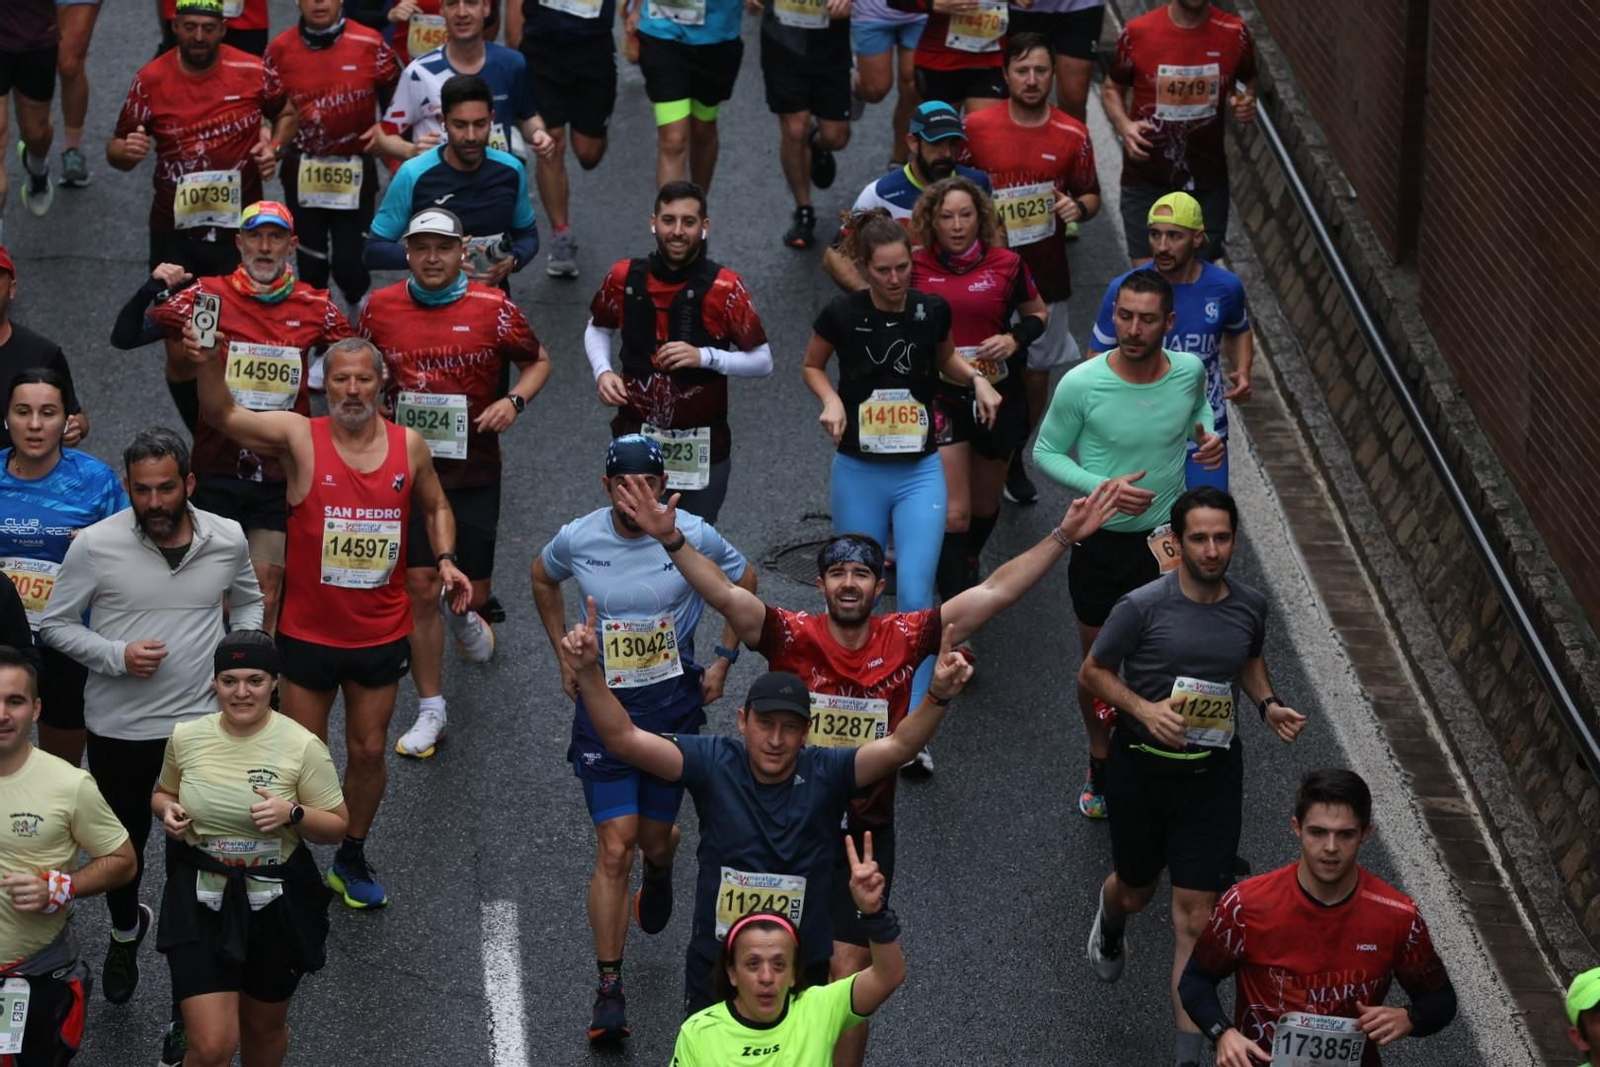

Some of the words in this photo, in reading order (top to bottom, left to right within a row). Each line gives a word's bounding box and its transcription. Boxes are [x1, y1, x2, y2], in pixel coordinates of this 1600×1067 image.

[1166, 80, 1205, 97] 4719
[305, 167, 353, 185] 11659
[180, 186, 230, 206] 10739
[996, 198, 1046, 223] 11623
[233, 358, 290, 383] 14596
[405, 409, 450, 431] 9524
[864, 405, 919, 425] 14165
[3, 517, 39, 527] CLUB
[324, 506, 353, 518] SAN
[356, 507, 401, 520] PEDRO
[329, 536, 389, 560] 14597
[610, 632, 666, 658] 13042
[867, 658, 885, 669] HOKA
[1177, 697, 1231, 719] 11223
[810, 712, 875, 739] 13287
[725, 889, 790, 914] 11242
[1281, 1031, 1351, 1061] 17385
